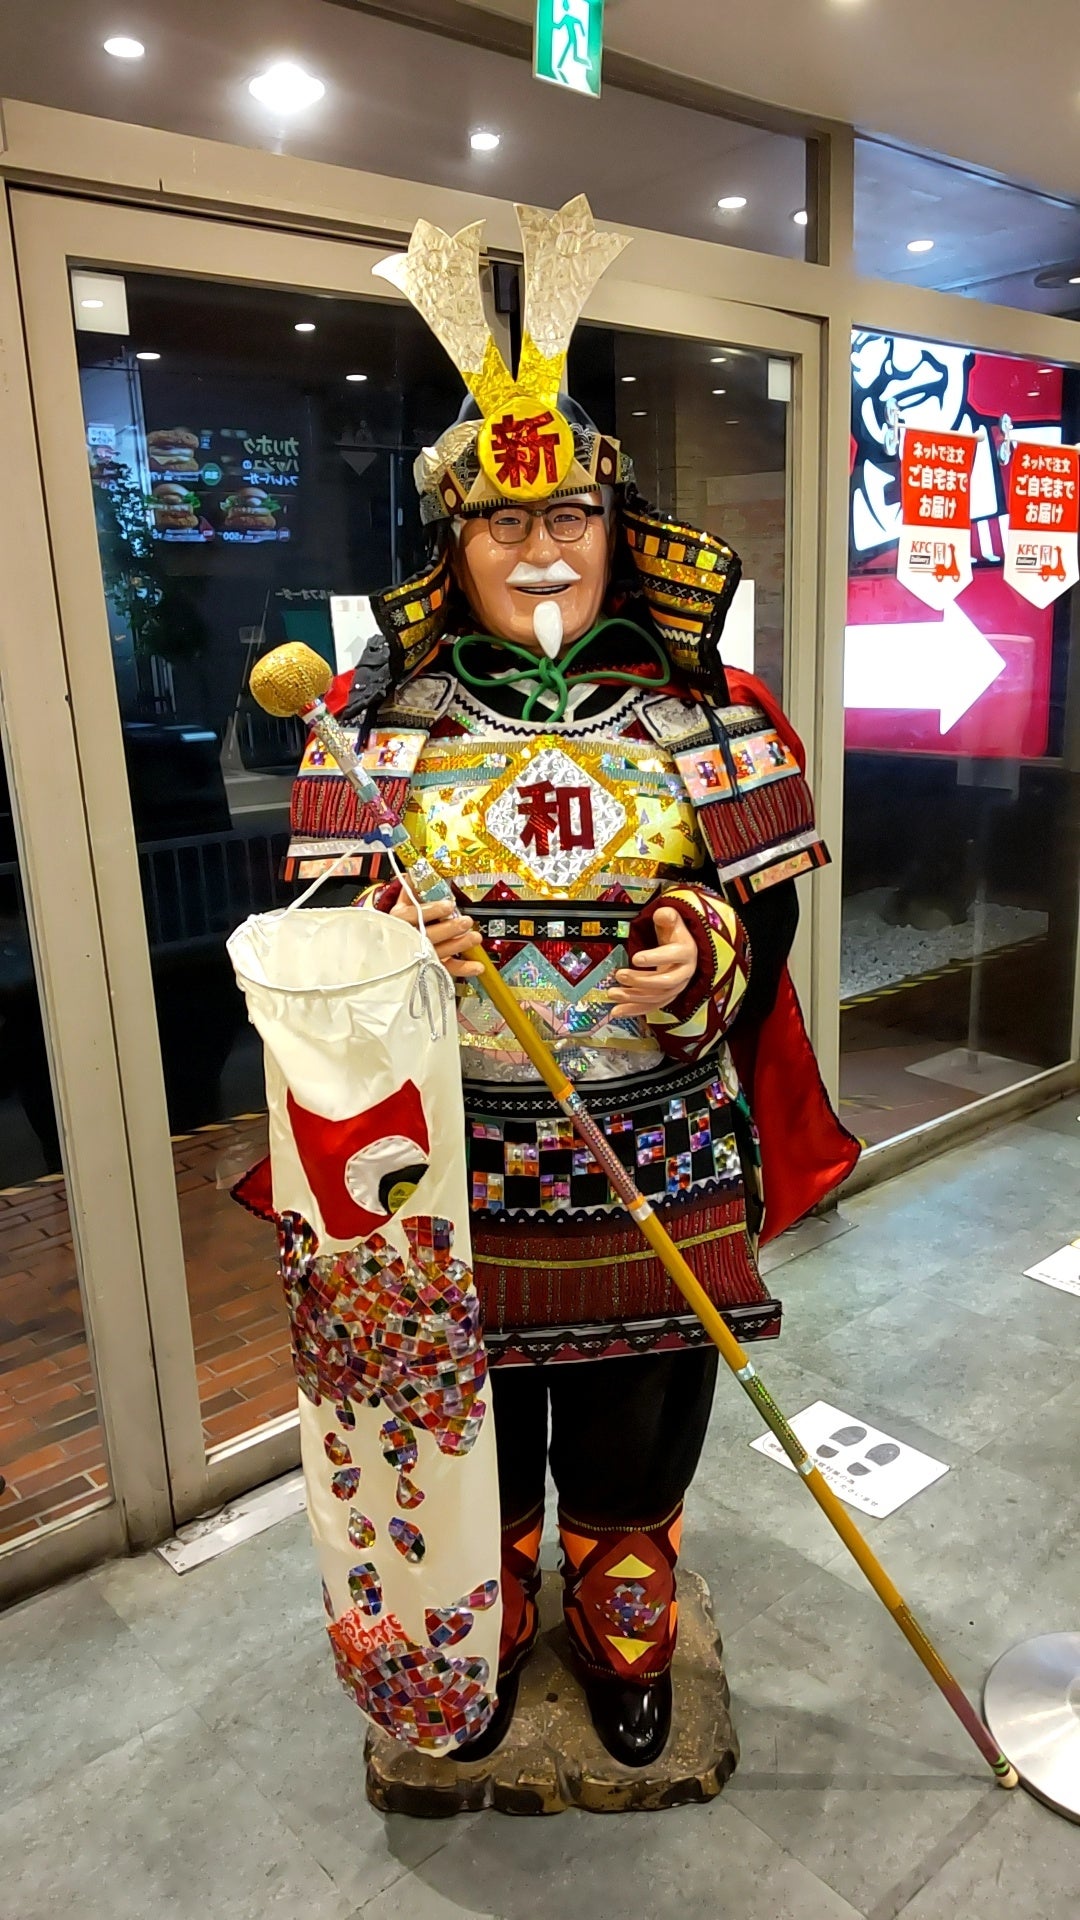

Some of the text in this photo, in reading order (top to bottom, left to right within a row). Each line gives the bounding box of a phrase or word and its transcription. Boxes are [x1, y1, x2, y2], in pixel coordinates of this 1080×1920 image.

[491, 410, 560, 488] 新
[913, 441, 966, 464] ネットで注文
[1021, 454, 1071, 473] ネットで注文
[908, 464, 968, 493] ご自宅まで
[1016, 474, 1075, 499] ご自宅まで
[919, 494, 957, 520] お届け
[1025, 502, 1064, 525] お届け
[910, 540, 932, 553] KFC
[1017, 544, 1038, 555] KFC
[516, 780, 595, 857] 和
